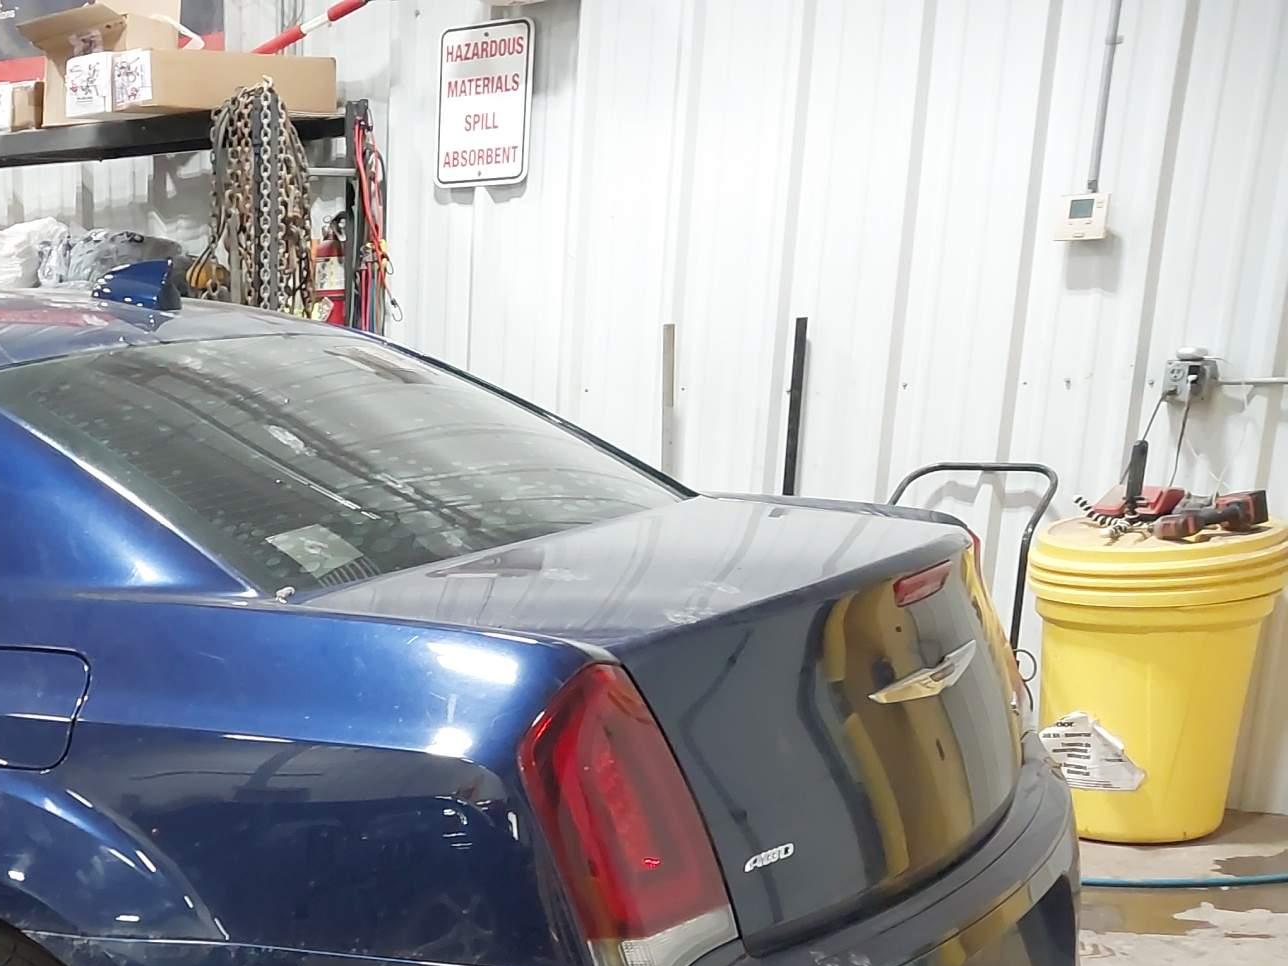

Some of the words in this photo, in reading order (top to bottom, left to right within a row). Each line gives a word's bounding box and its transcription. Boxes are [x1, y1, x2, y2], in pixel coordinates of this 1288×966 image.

[446, 36, 525, 62] HAZARDOUS
[447, 73, 521, 98] MATERIALS
[464, 111, 499, 131] SPILL
[443, 145, 519, 168] ABSORBENT
